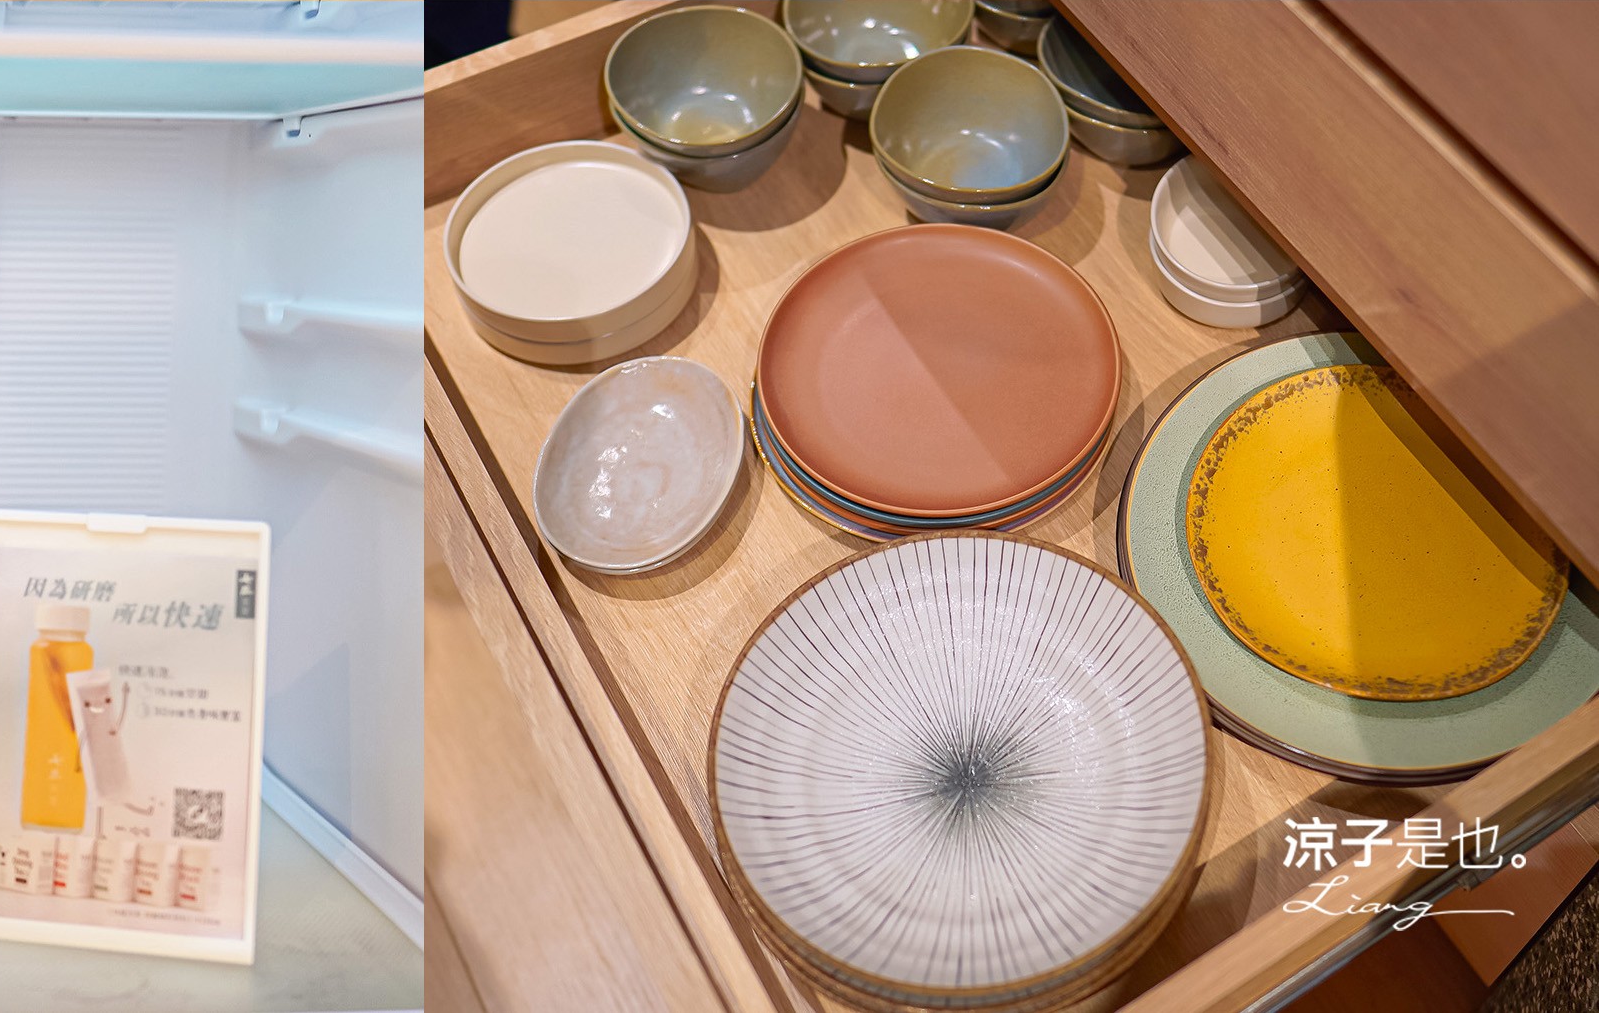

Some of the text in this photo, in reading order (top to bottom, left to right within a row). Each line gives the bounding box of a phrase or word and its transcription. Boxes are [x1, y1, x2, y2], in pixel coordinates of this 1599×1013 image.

[23, 576, 117, 602] 因為研磨
[112, 600, 225, 631] 所以快速
